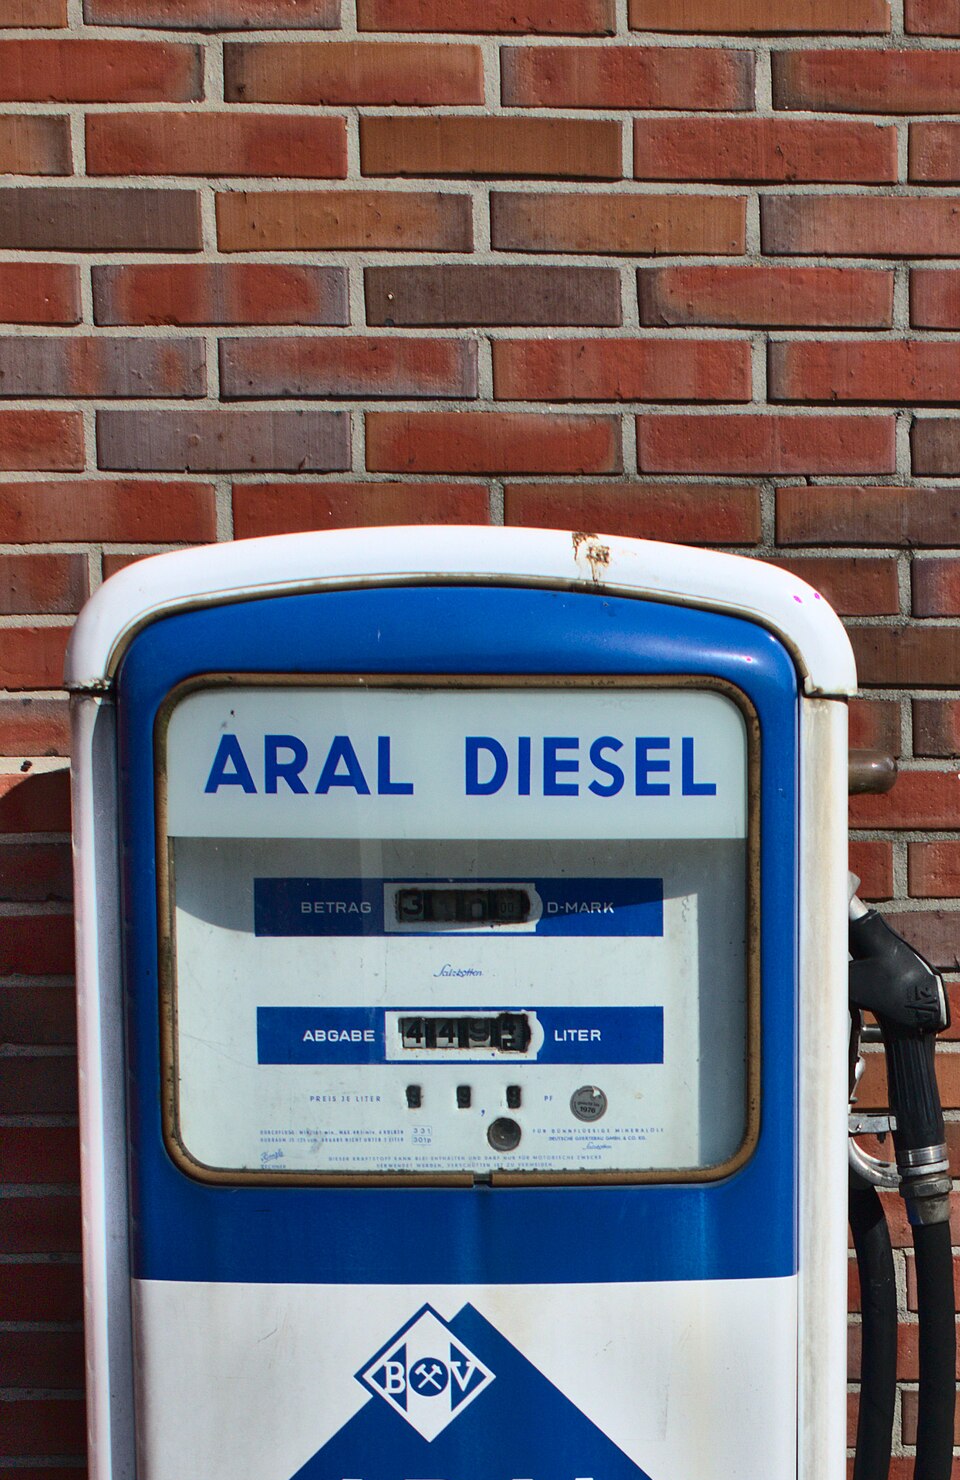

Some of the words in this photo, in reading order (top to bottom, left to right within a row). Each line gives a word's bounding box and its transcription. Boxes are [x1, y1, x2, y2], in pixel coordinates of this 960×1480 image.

[204, 734, 414, 795] ARAL
[465, 736, 717, 797] DIESEL
[300, 902, 372, 914] BETRAG
[547, 902, 615, 914] D-MARK
[303, 1030, 376, 1042] ABGABE
[554, 1030, 602, 1041] LITER
[309, 1095, 337, 1103] PREIS
[341, 1095, 351, 1103] JE
[356, 1095, 381, 1103] LITER
